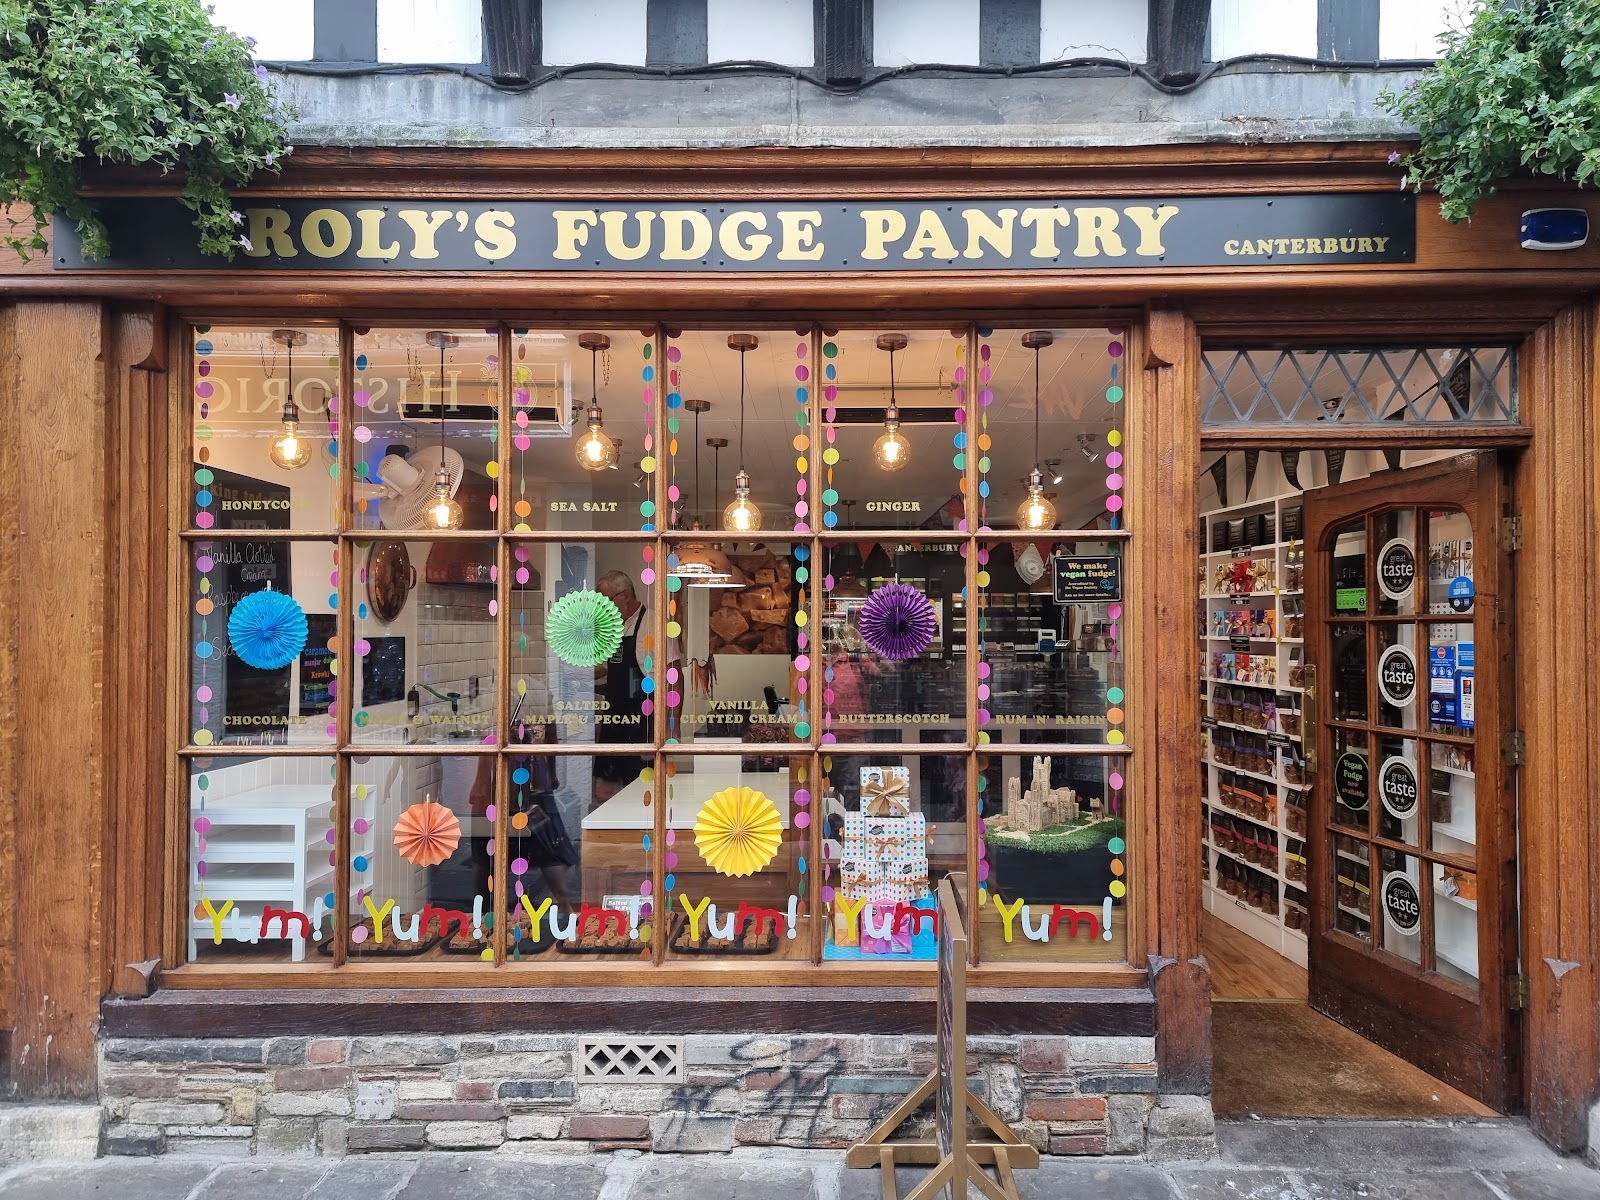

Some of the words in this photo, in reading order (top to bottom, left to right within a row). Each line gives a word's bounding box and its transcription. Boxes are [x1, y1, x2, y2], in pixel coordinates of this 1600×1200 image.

[246, 208, 518, 261] ROLY'S
[552, 209, 825, 262] FUDGE
[860, 205, 1180, 260] PANTRY
[1224, 235, 1391, 256] CANTERBURY
[222, 500, 311, 511] HONEYCO
[550, 502, 578, 512] SEA
[583, 502, 618, 512] SALT
[866, 501, 921, 512] GINGER
[1390, 553, 1406, 564] great
[1060, 571, 1086, 579] vegan
[1087, 570, 1116, 578] fudge!
[1383, 563, 1414, 577] taste
[1390, 662, 1407, 671] great
[1384, 669, 1414, 684] taste
[556, 700, 610, 711] SALTED
[709, 700, 769, 710] VANILLA
[222, 715, 308, 725] CHOCOLATE
[429, 715, 491, 725] WALNUT
[526, 714, 572, 725] MAPLE
[595, 714, 641, 725] PECAN
[680, 714, 744, 724] CLOTTED
[749, 714, 798, 724] CREAM
[839, 714, 950, 724] BUTTERSCOTCH
[995, 714, 1027, 725] RUM
[1055, 715, 1106, 725] RAISIN
[1343, 760, 1363, 771] Vegan
[1343, 770, 1363, 781] Fudge
[1392, 773, 1408, 782] great
[1385, 780, 1416, 798] taste
[1394, 888, 1410, 898] great
[1387, 893, 1418, 916] taste
[202, 896, 324, 945] Yum!
[363, 894, 483, 943] Yum!
[521, 894, 640, 942] Yum!
[679, 893, 798, 941] Yum!
[835, 894, 939, 941] Yum
[993, 894, 1113, 943] Yum!
